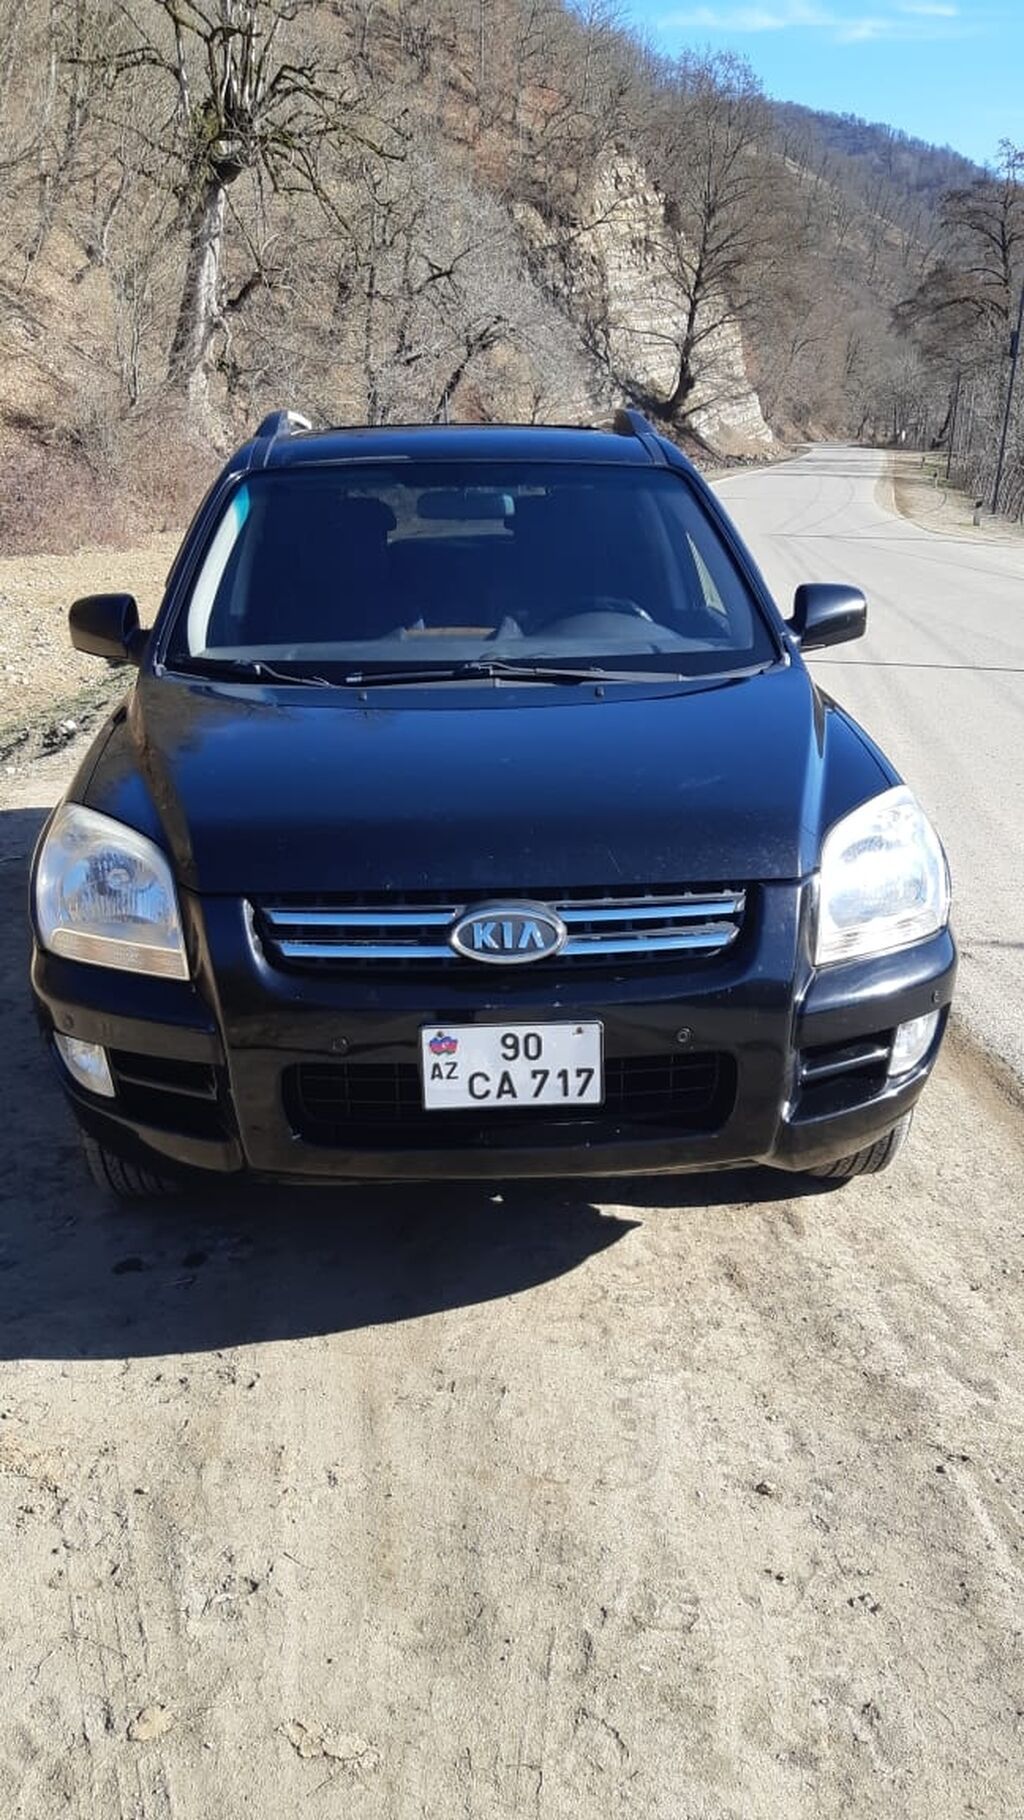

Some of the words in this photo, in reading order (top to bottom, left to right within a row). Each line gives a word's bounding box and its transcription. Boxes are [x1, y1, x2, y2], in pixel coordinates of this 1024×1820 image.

[472, 921, 545, 949] KIA
[501, 1033, 542, 1061] 90
[430, 1062, 459, 1080] AZ
[468, 1071, 518, 1099] CA
[531, 1068, 595, 1098] 717
